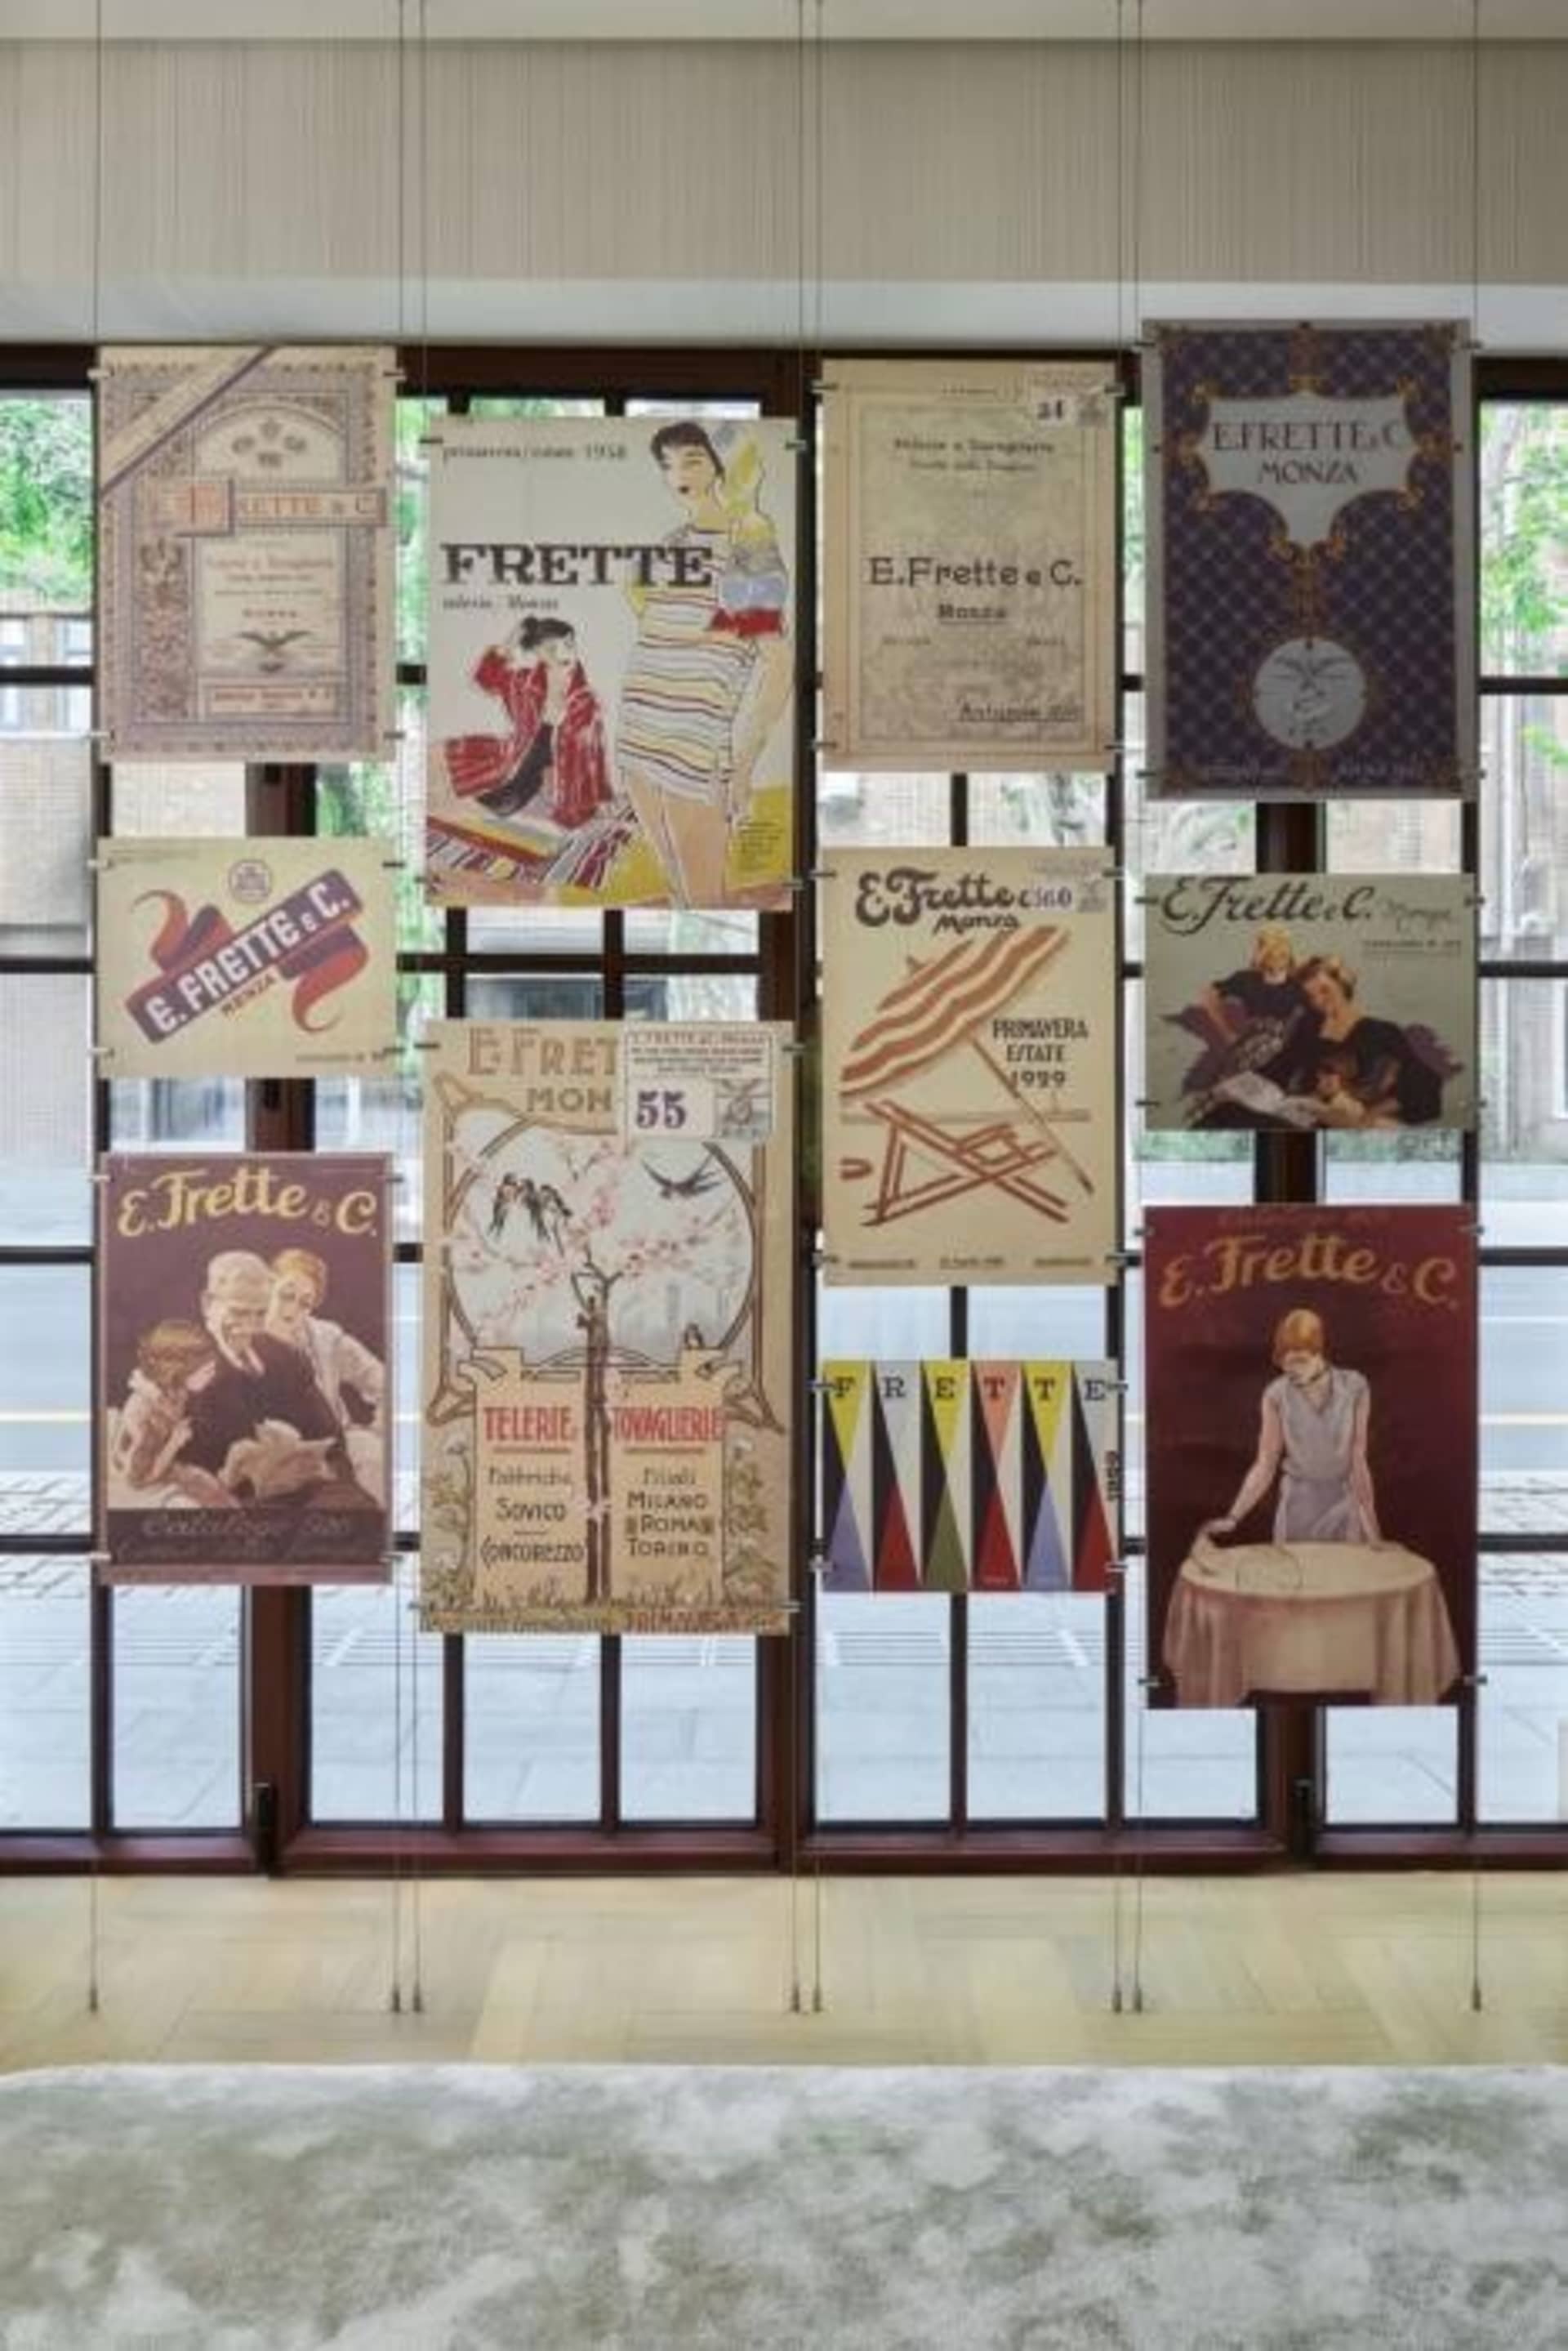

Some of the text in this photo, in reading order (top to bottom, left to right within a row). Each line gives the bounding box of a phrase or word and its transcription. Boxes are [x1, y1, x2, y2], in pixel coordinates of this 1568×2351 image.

[1259, 461, 1359, 484] MONZA
[440, 543, 713, 587] FRETTE
[177, 909, 301, 1012] FRETTE
[992, 1018, 1089, 1039] PRIMAVERA
[1006, 1044, 1066, 1063] ESTATE
[636, 1090, 687, 1129] 55
[150, 1167, 308, 1229] Frette
[1204, 1233, 1381, 1293] Frette
[483, 1406, 575, 1441] TELERIE
